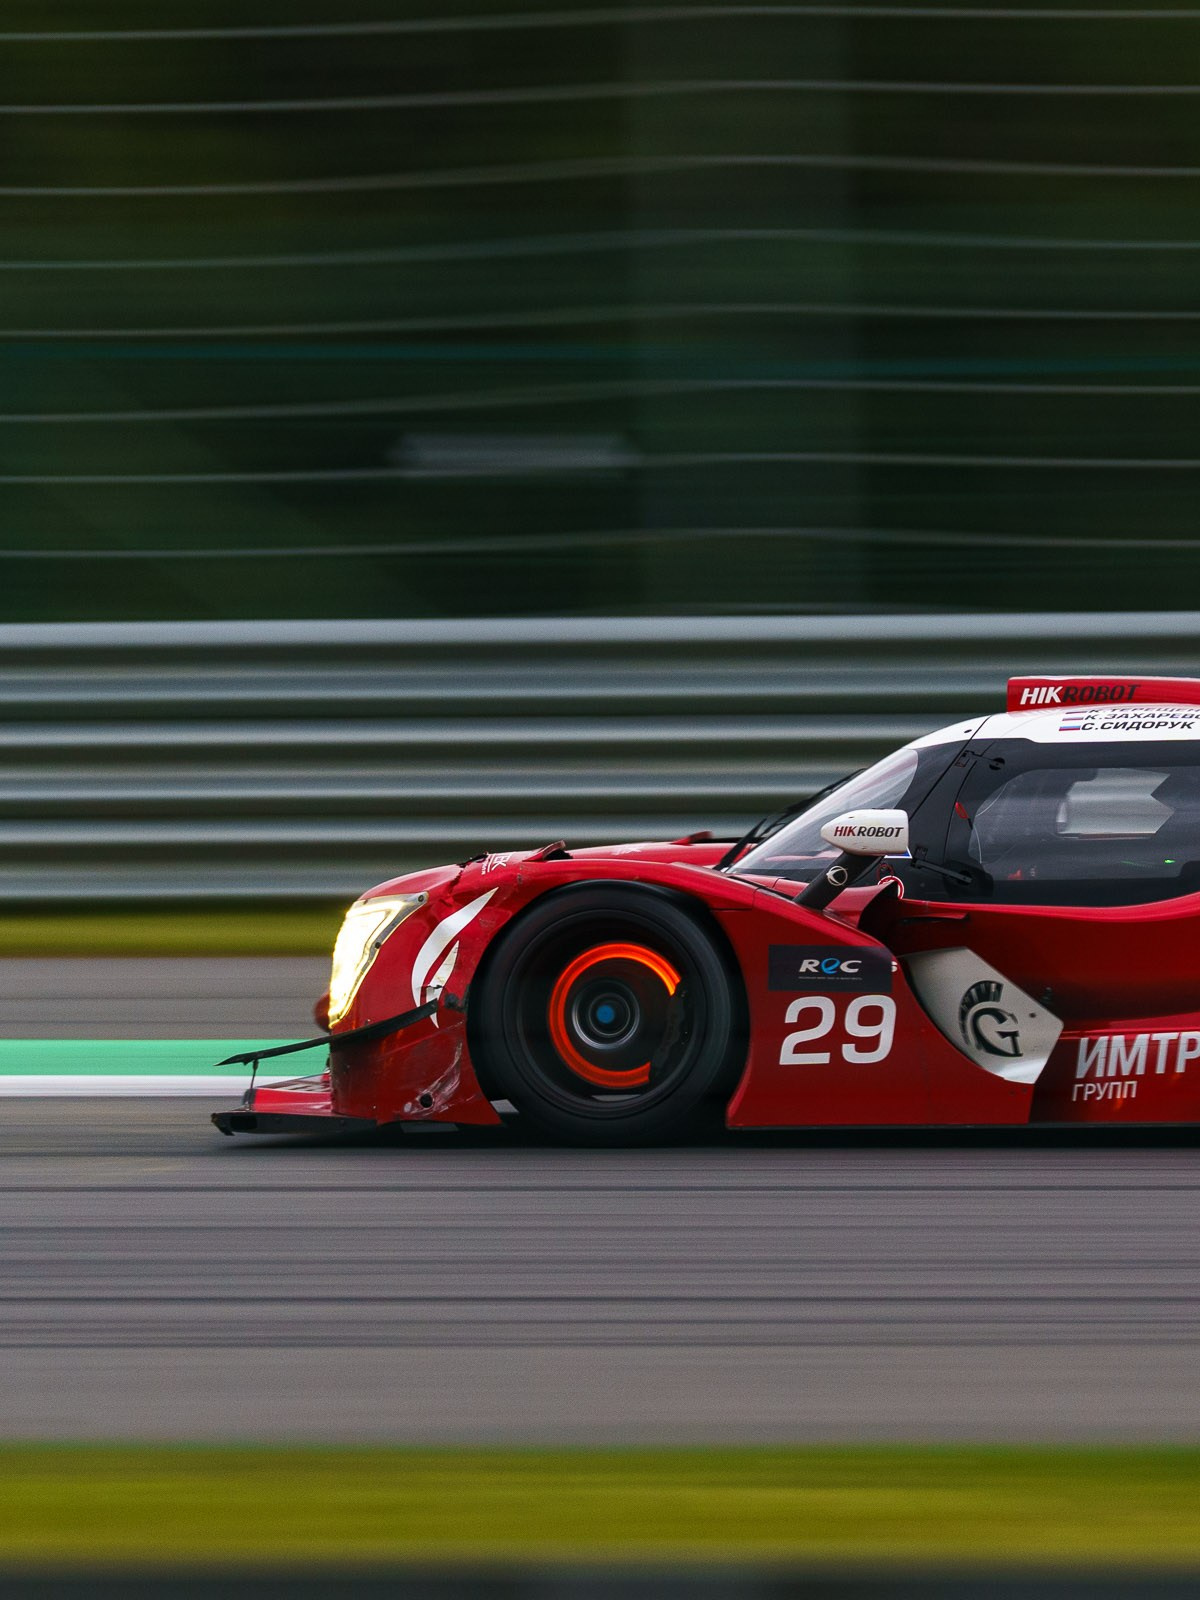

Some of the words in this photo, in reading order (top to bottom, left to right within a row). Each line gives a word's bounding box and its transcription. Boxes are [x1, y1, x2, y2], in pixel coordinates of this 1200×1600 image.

[1020, 685, 1141, 704] HIKROBOT
[1081, 721, 1195, 730] С.СИДОРУК
[833, 826, 904, 838] HIKROBOT
[779, 994, 897, 1065] 29
[1072, 1081, 1138, 1102] ГРУПП
